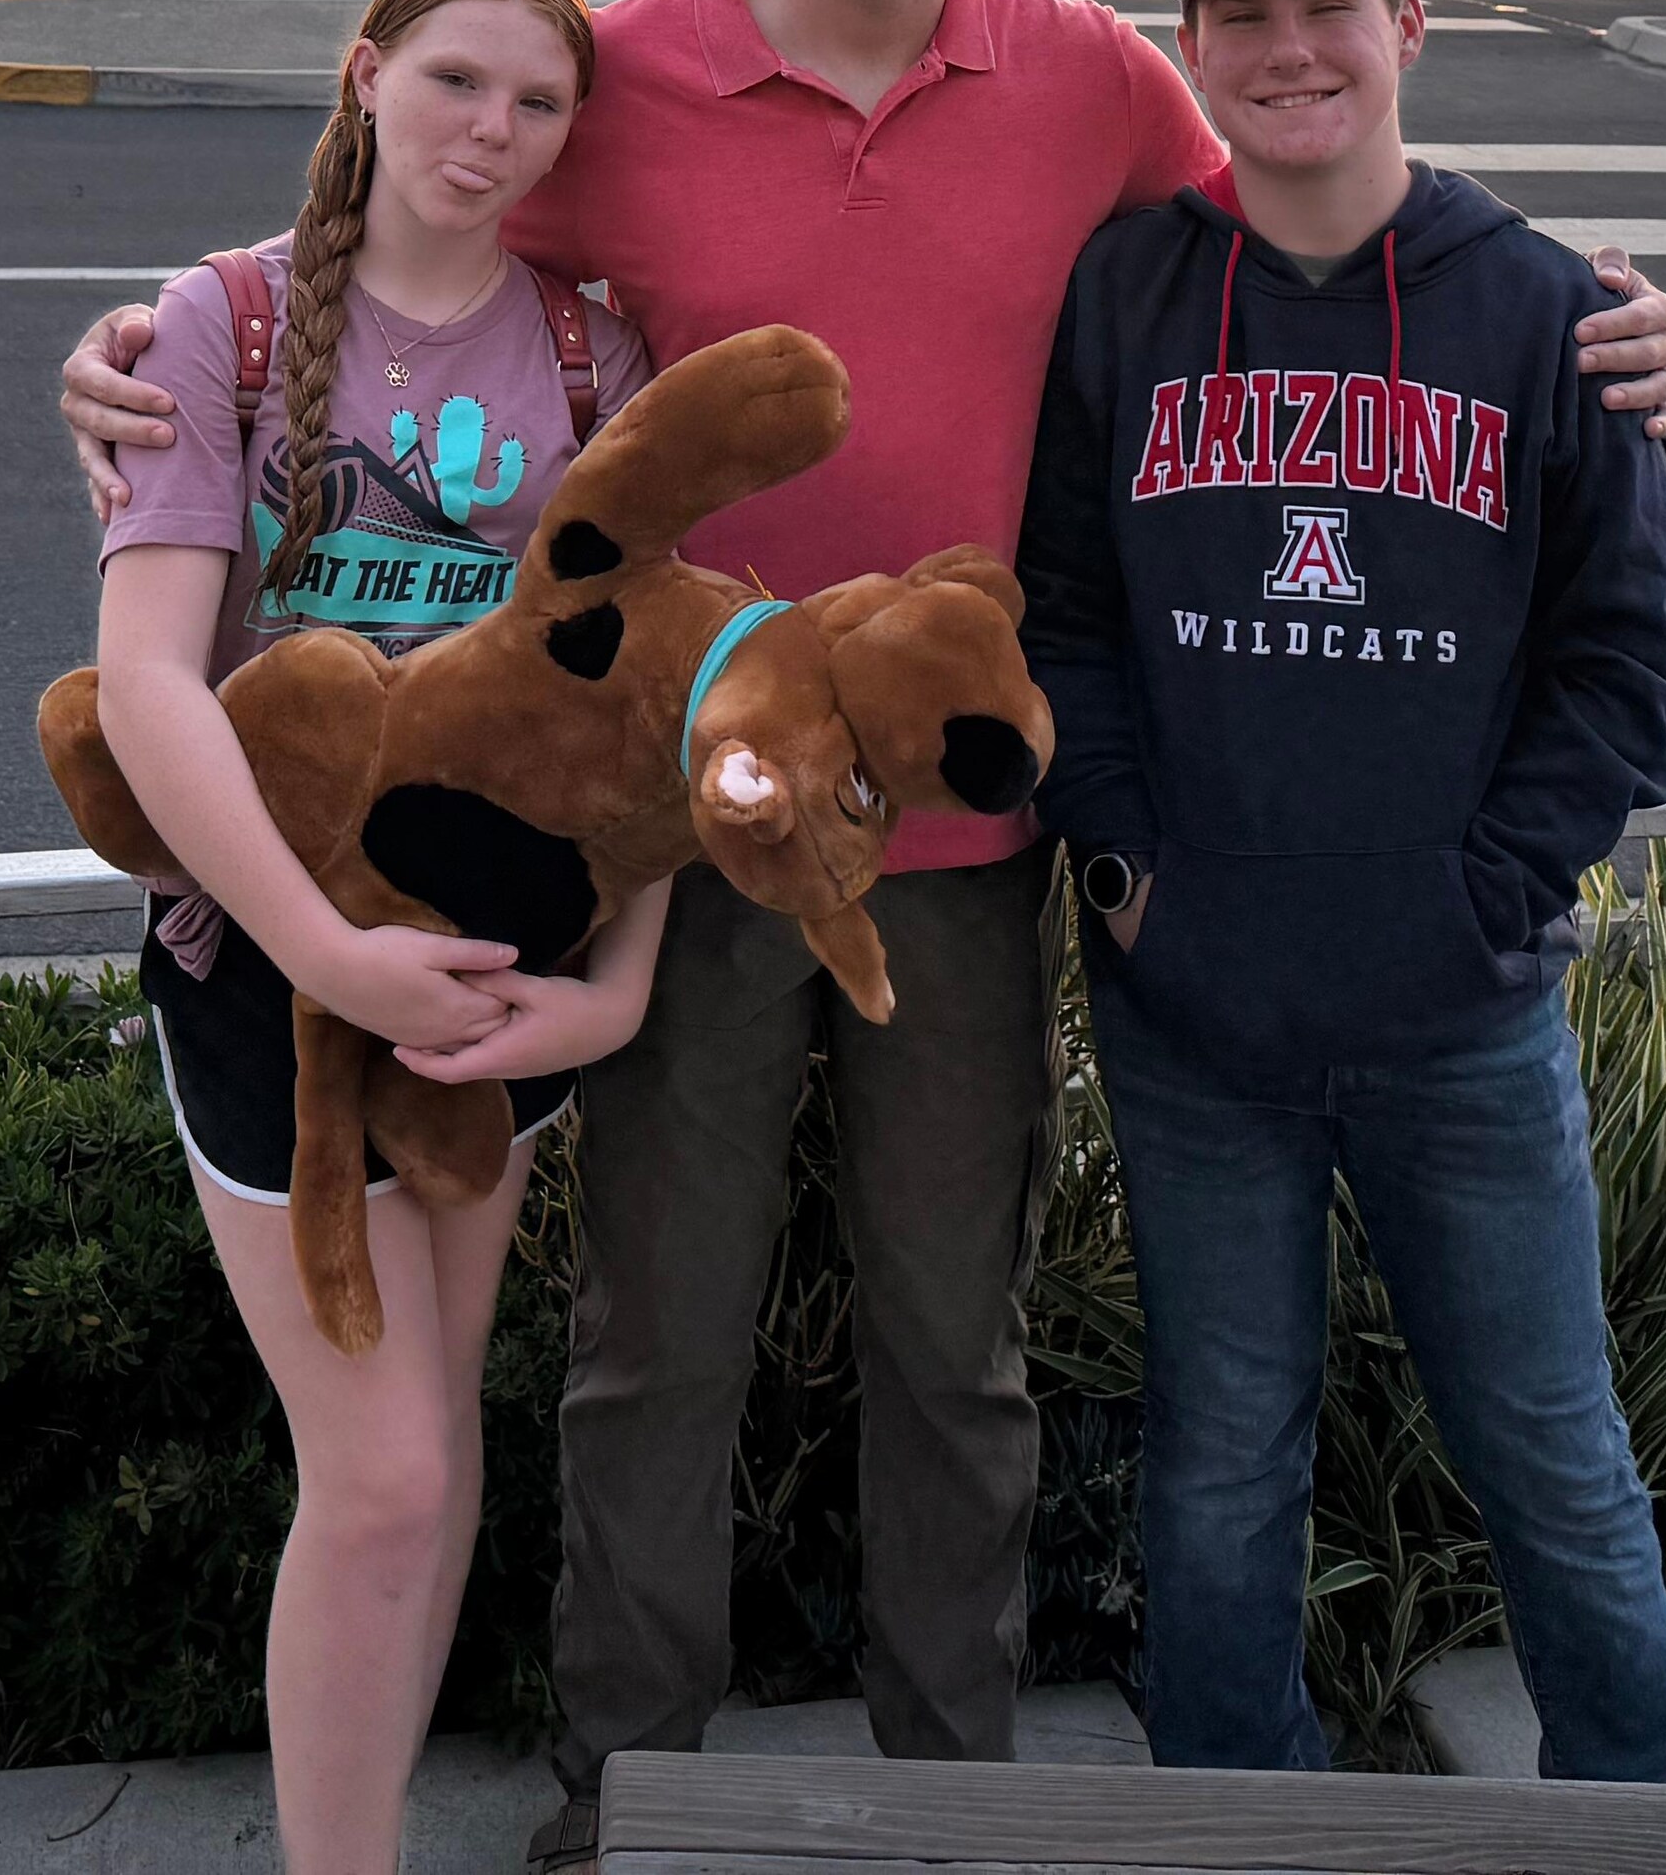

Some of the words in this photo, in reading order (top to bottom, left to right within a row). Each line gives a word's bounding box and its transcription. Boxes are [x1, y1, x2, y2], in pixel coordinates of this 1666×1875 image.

[1132, 369, 1508, 532] ARIZONA
[352, 559, 422, 602] THE
[424, 561, 515, 605] HEAT
[1264, 505, 1365, 605] A
[1171, 609, 1458, 663] WILDCATS
